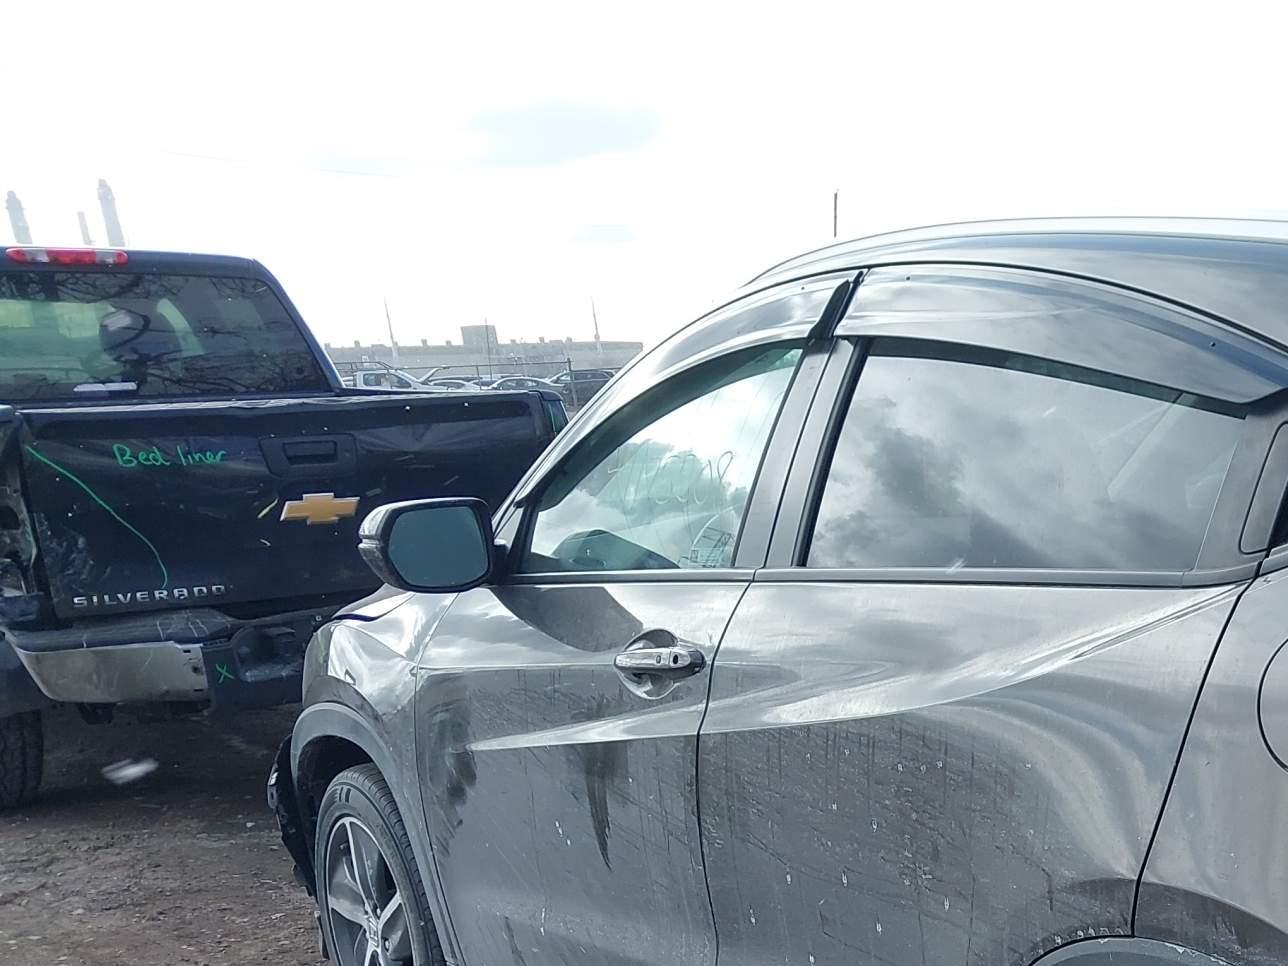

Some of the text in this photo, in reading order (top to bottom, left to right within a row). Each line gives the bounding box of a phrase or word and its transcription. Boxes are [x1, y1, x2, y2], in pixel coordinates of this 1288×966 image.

[112, 443, 226, 467] Bed liner
[72, 585, 225, 607] SILVERADO
